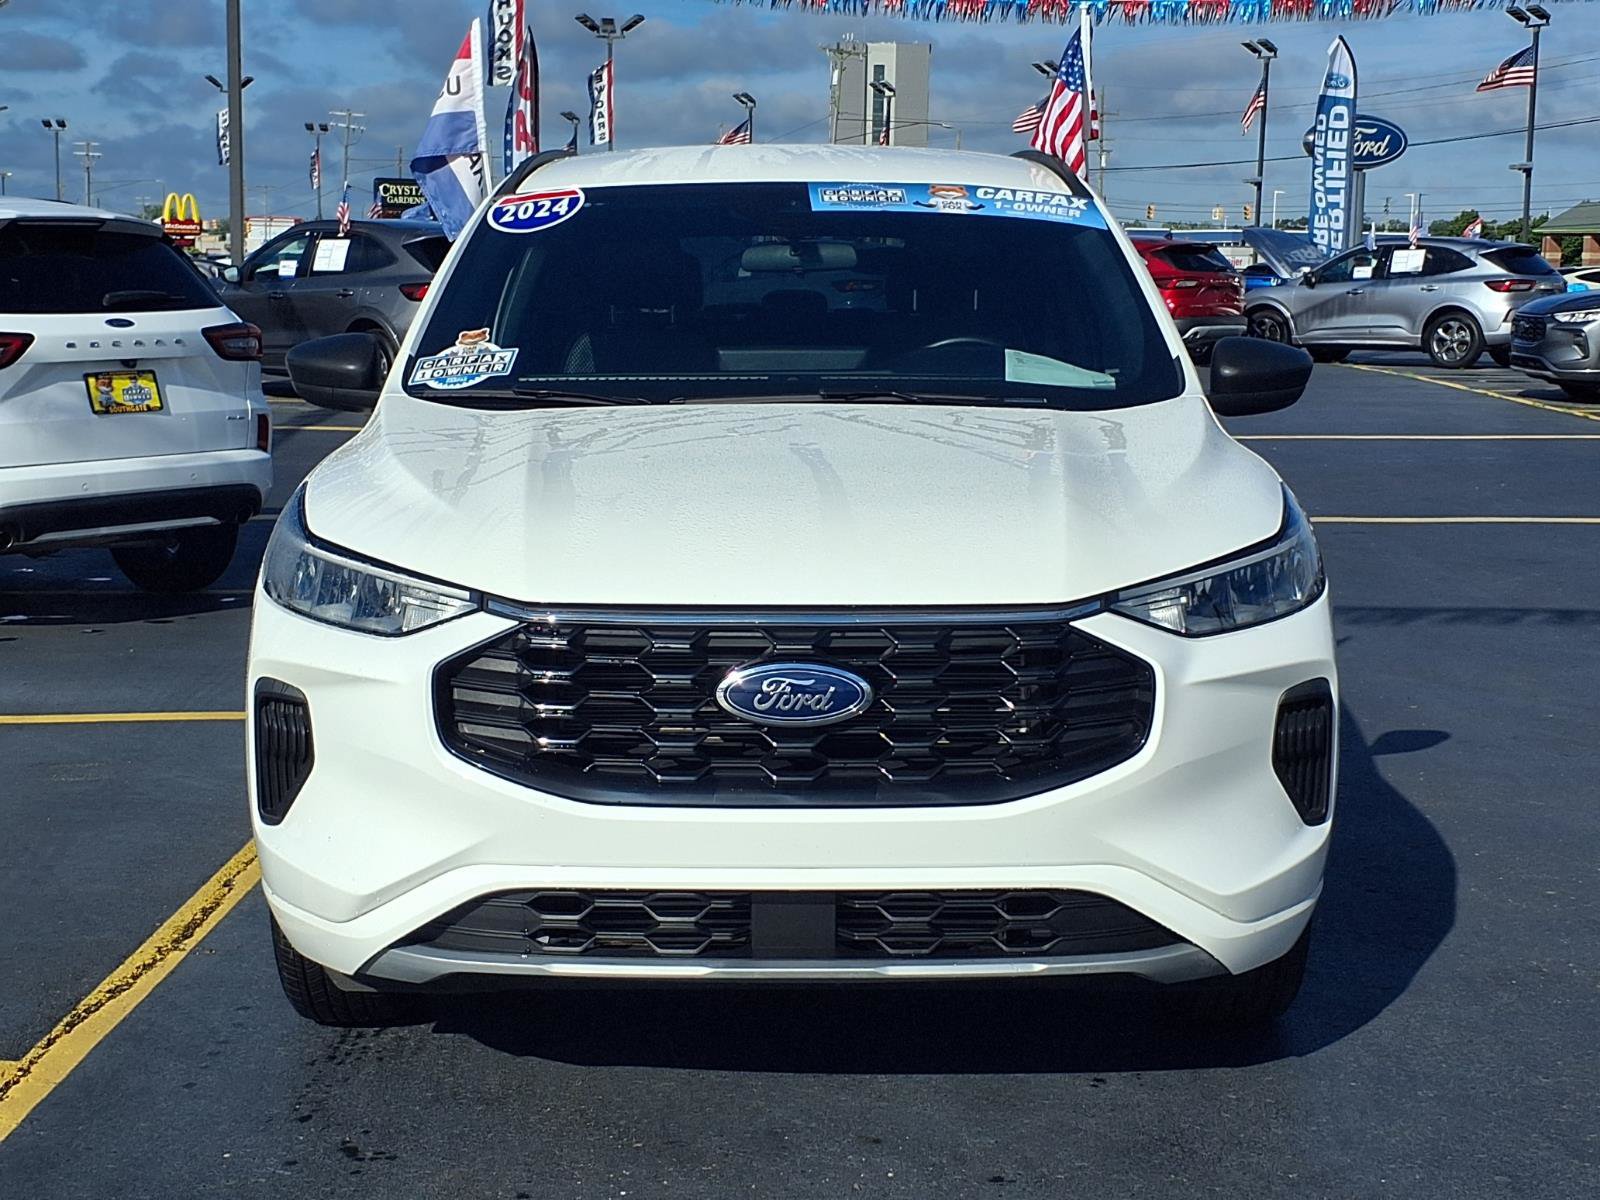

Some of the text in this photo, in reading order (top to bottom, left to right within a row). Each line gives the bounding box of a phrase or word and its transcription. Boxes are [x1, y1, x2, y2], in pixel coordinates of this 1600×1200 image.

[824, 189, 902, 197] CARFAX
[975, 187, 1089, 210] CARFAX
[498, 198, 570, 223] 2024
[993, 201, 1081, 217] 1-OWNER
[422, 354, 507, 369] CARFAX
[433, 363, 505, 377] OWNER
[753, 677, 834, 711] Ford
